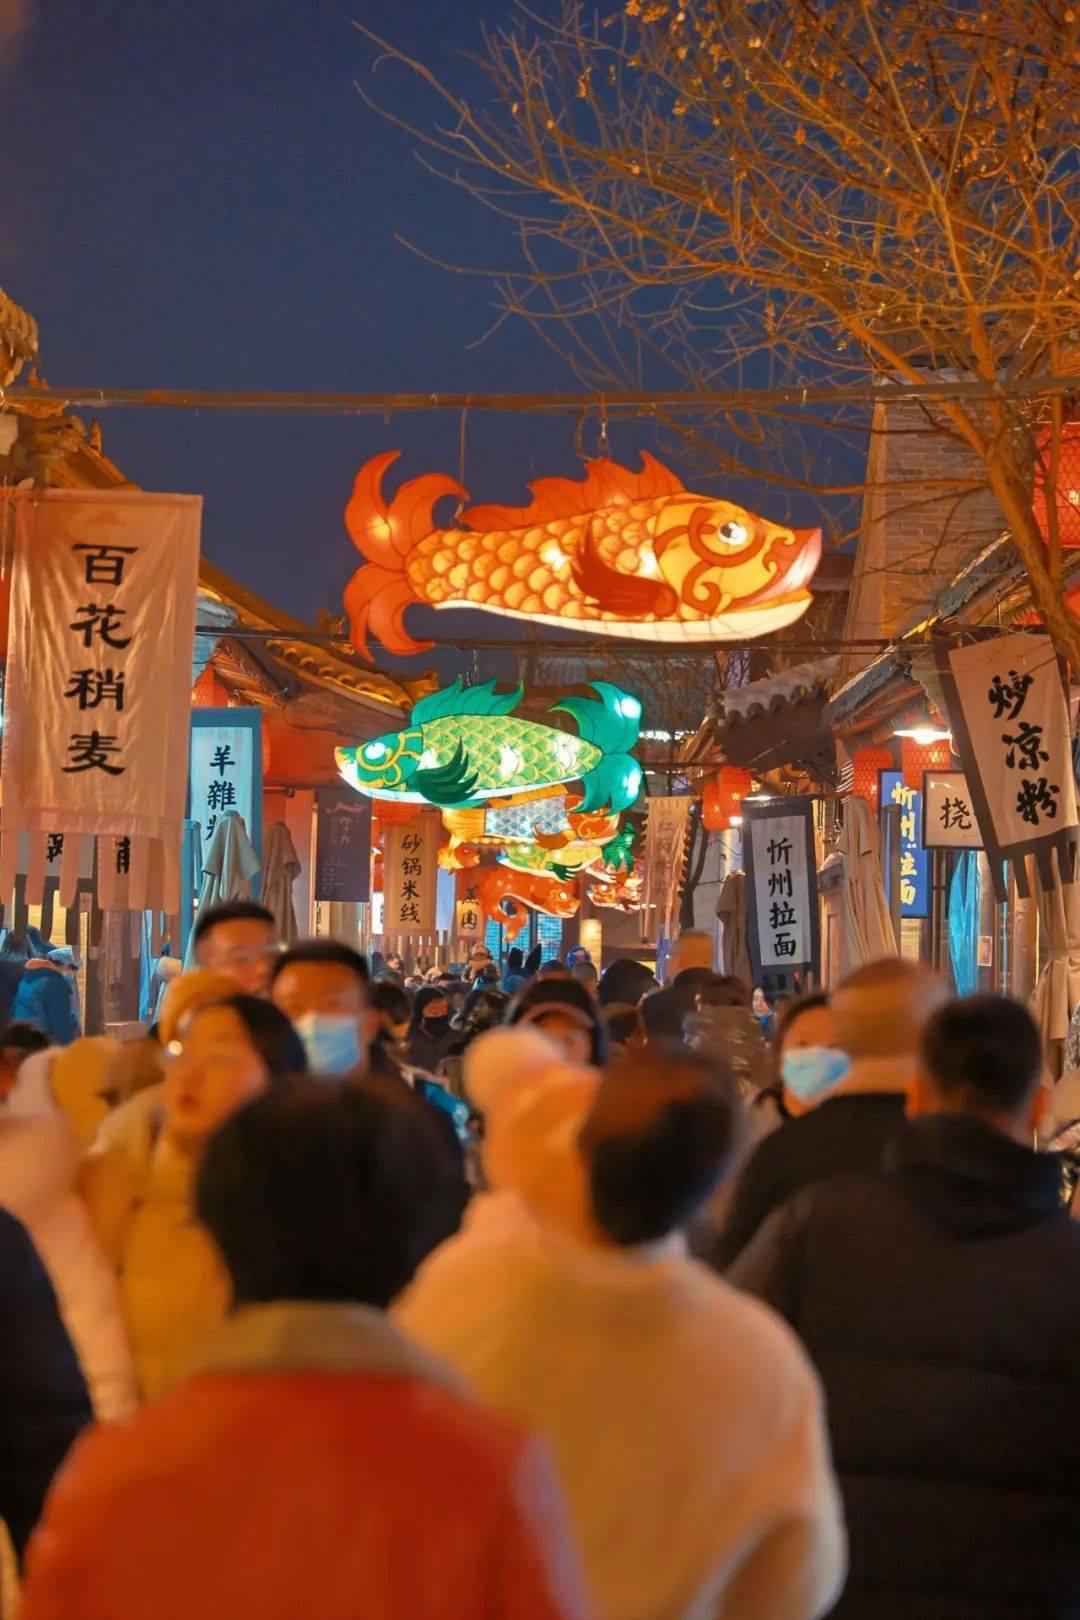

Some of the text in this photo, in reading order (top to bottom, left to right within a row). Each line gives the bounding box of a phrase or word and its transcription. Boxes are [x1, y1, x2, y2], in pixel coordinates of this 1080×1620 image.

[61, 543, 138, 776] 百花稍麦
[940, 797, 976, 830] 挠
[400, 833, 423, 924] 砂锅米线
[766, 837, 797, 957] 忻州拉面
